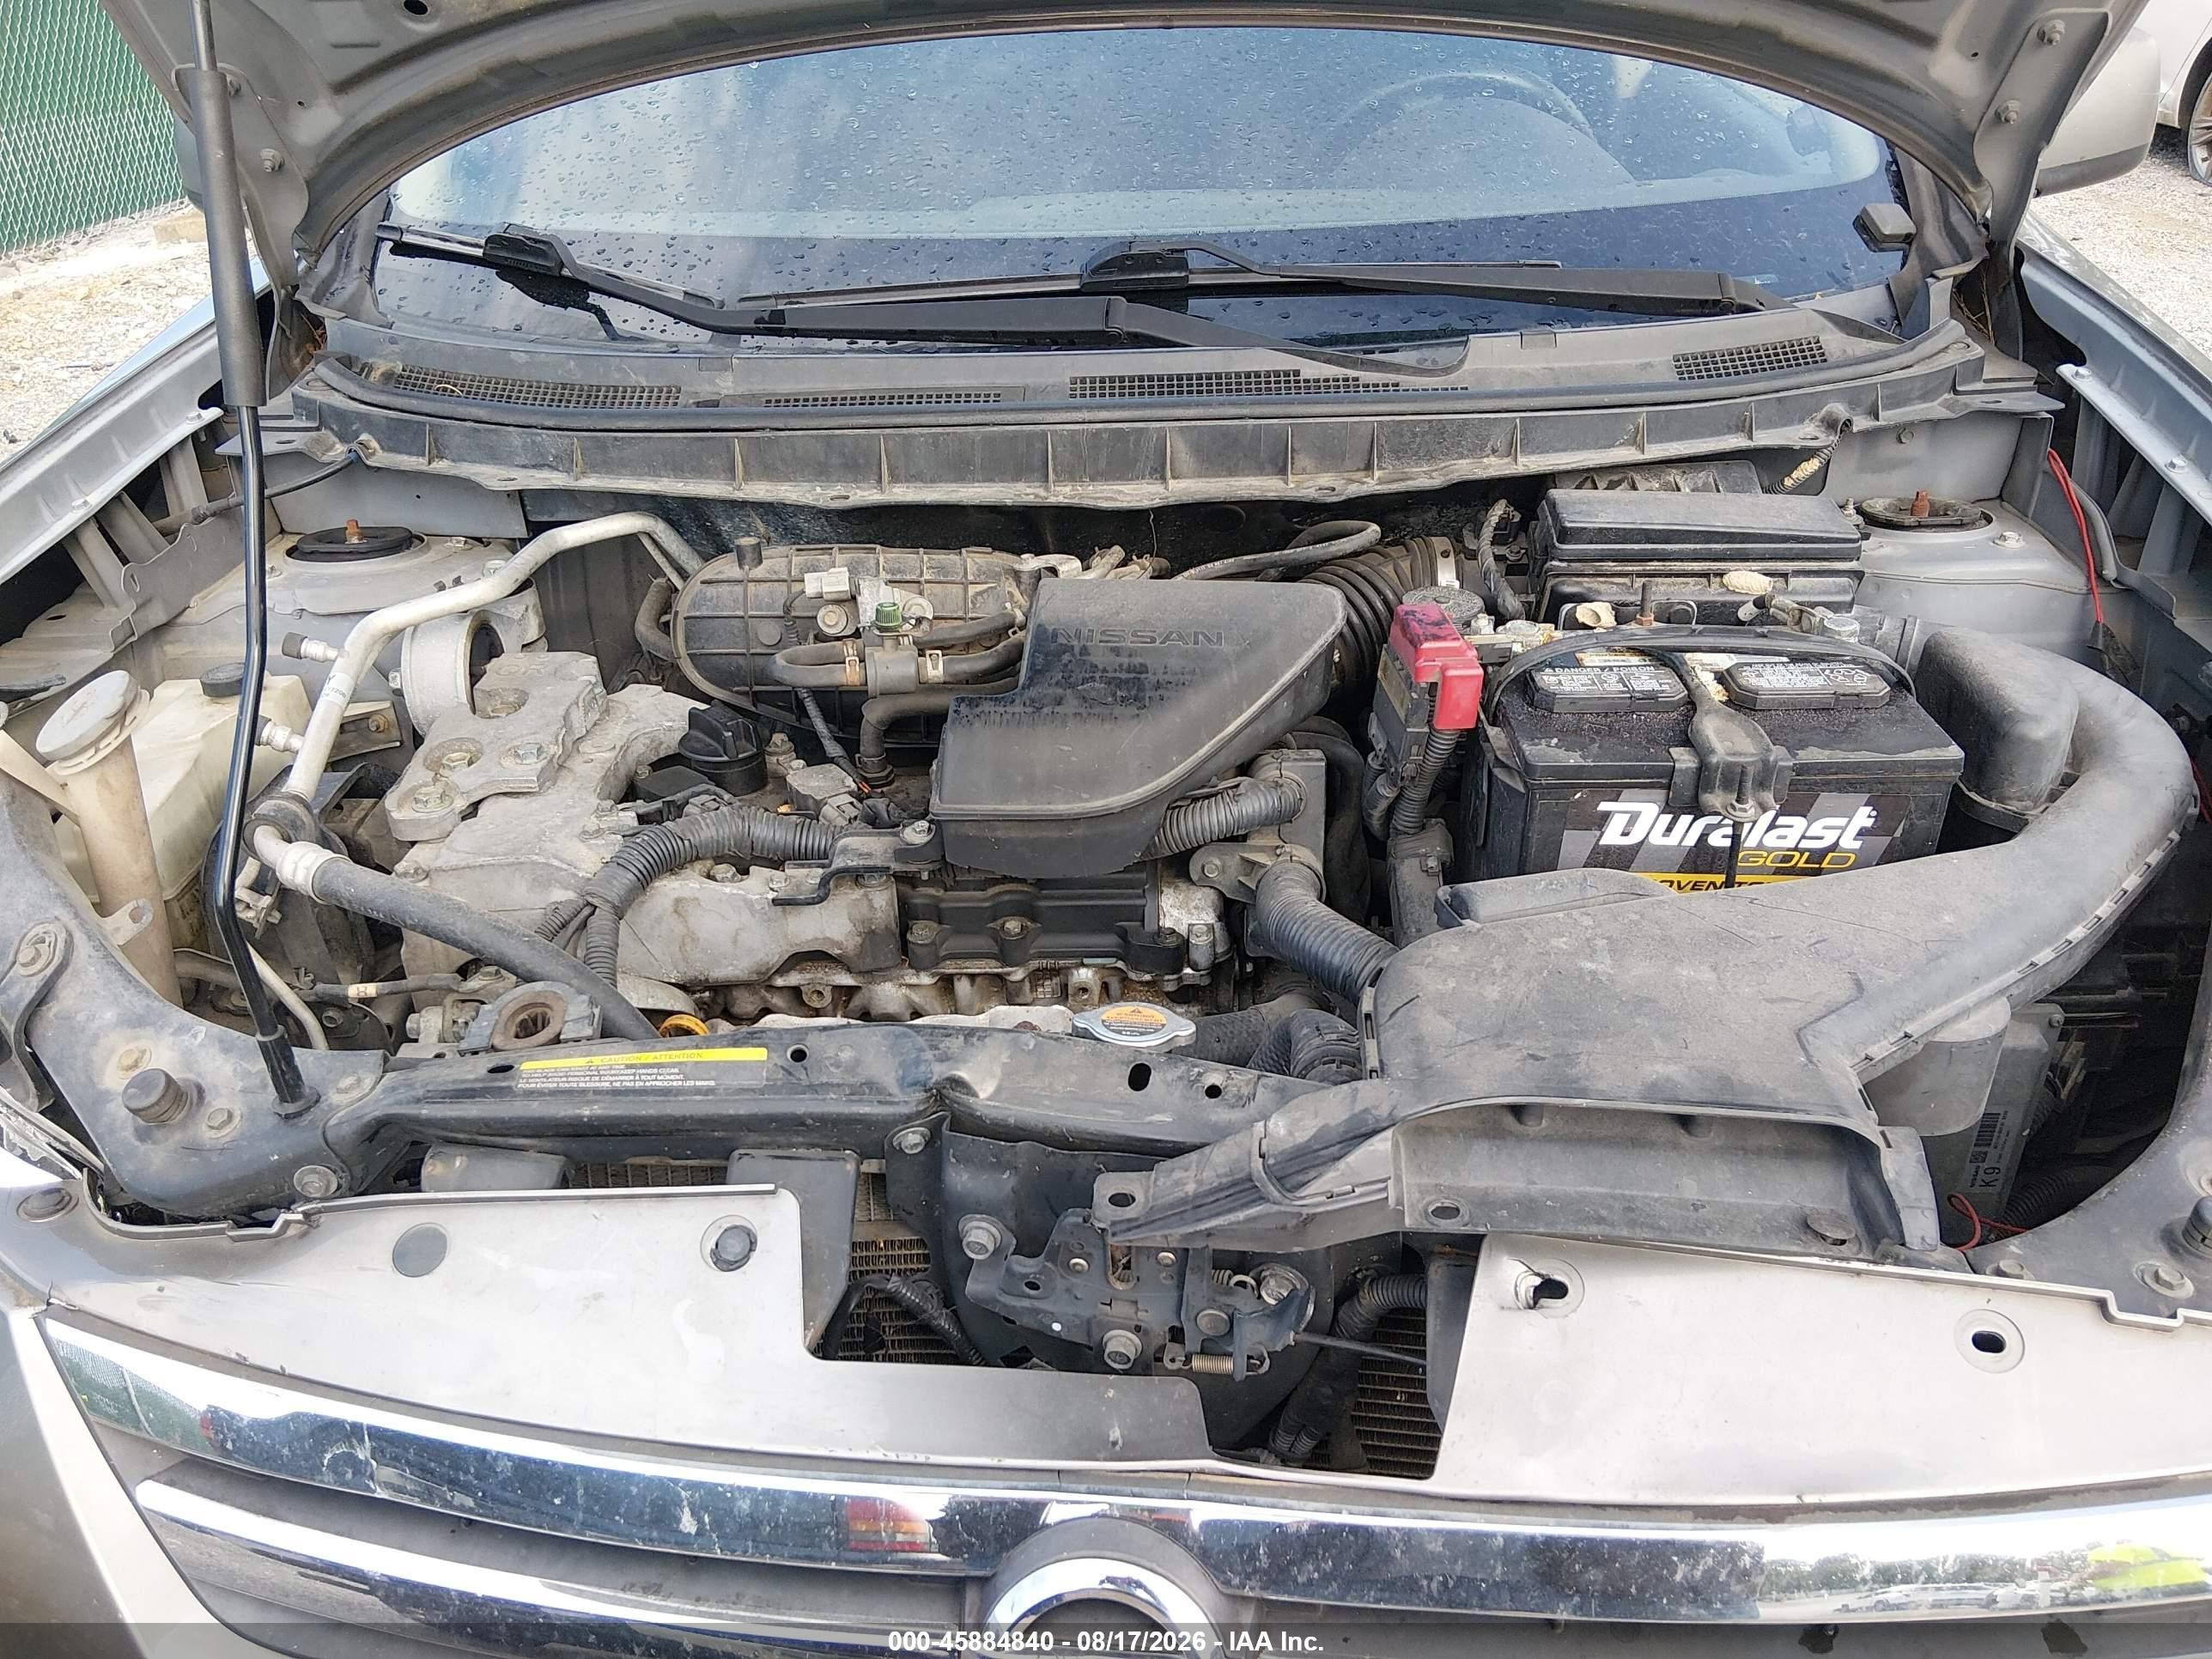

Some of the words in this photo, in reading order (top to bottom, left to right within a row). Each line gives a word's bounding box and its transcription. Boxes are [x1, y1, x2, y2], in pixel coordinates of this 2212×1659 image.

[1051, 628, 1224, 647] NISSAN
[1596, 801, 1876, 849] Duralast
[1736, 850, 1856, 869] GOLD
[1658, 879, 1726, 891] OVEN
[600, 1054, 641, 1064] CAUTION
[652, 1052, 703, 1060] ATTENTION
